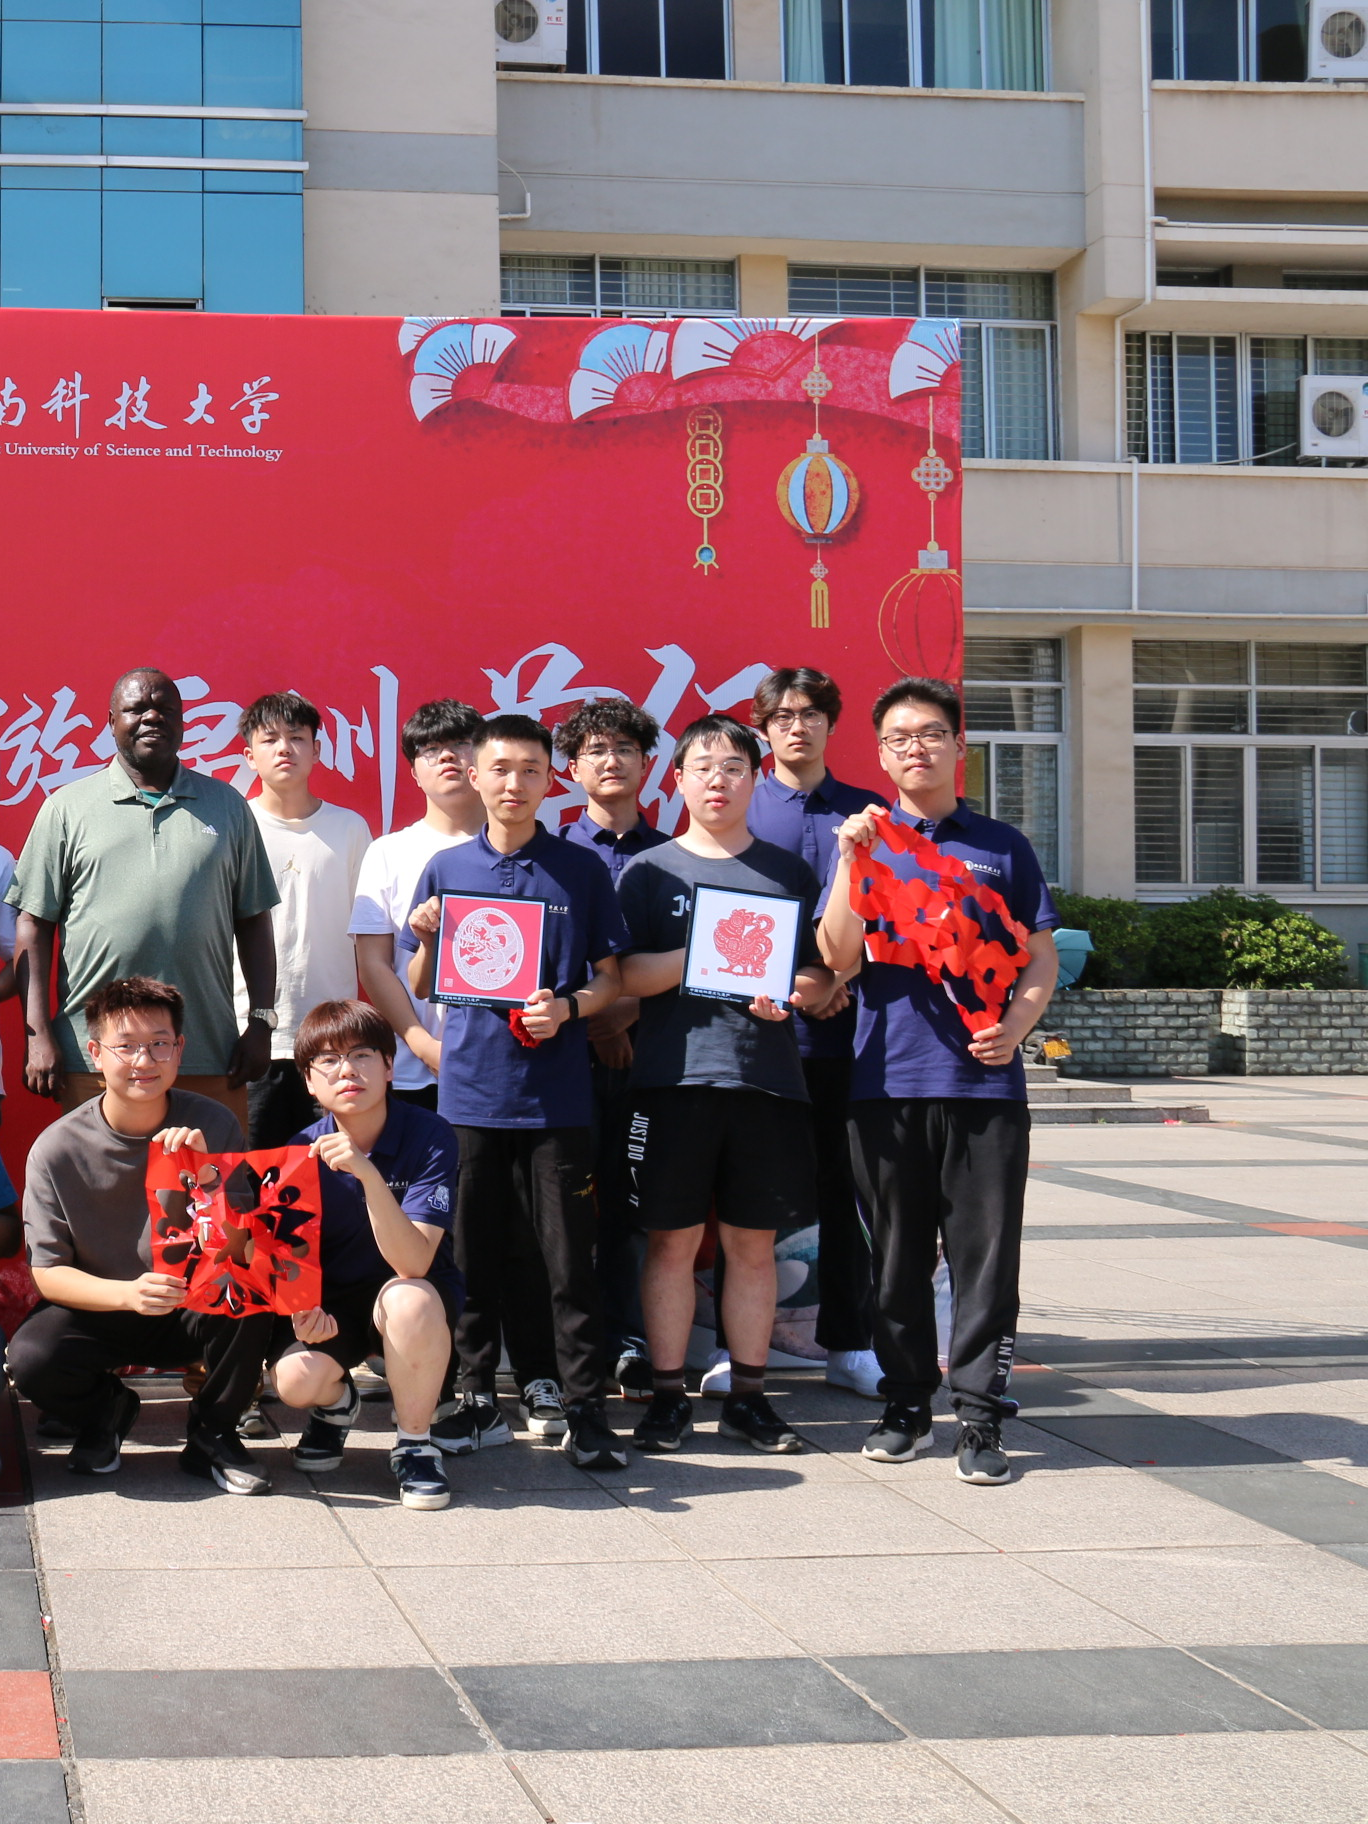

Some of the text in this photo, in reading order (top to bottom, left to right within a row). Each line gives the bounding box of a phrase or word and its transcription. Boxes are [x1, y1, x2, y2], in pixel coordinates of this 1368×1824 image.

[4, 442, 80, 459] University
[83, 442, 102, 456] of
[106, 443, 161, 457] Science
[165, 443, 193, 457] and
[196, 444, 283, 462] Technology
[627, 1111, 650, 1208] JUST DO IT
[997, 1335, 1013, 1376] ANTA
